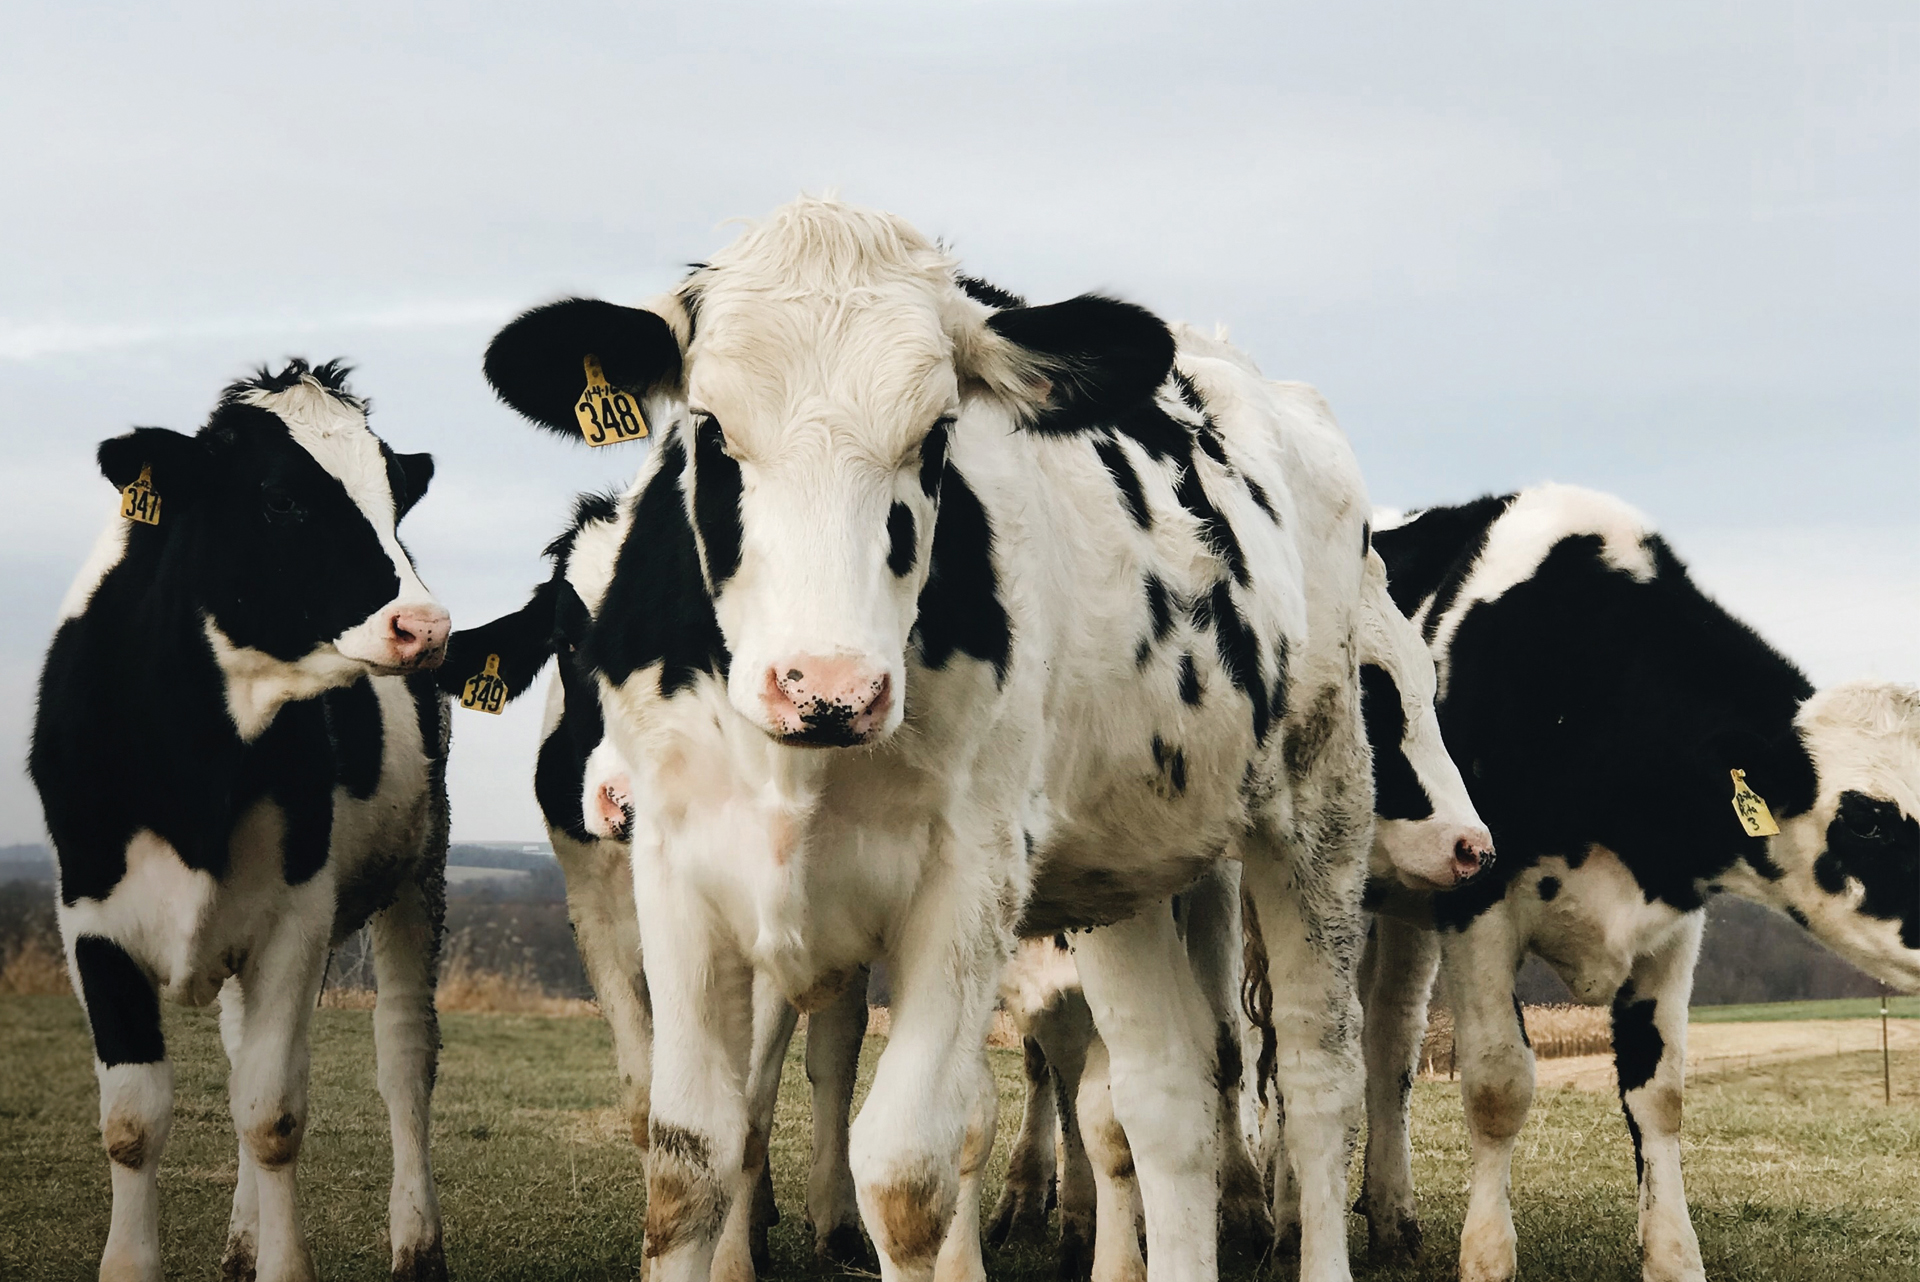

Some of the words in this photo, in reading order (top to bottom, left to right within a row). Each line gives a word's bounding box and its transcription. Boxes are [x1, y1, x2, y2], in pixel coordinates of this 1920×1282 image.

[579, 394, 640, 443] 348
[125, 487, 159, 522] 347
[463, 678, 504, 712] 349
[1747, 817, 1760, 831] 3
